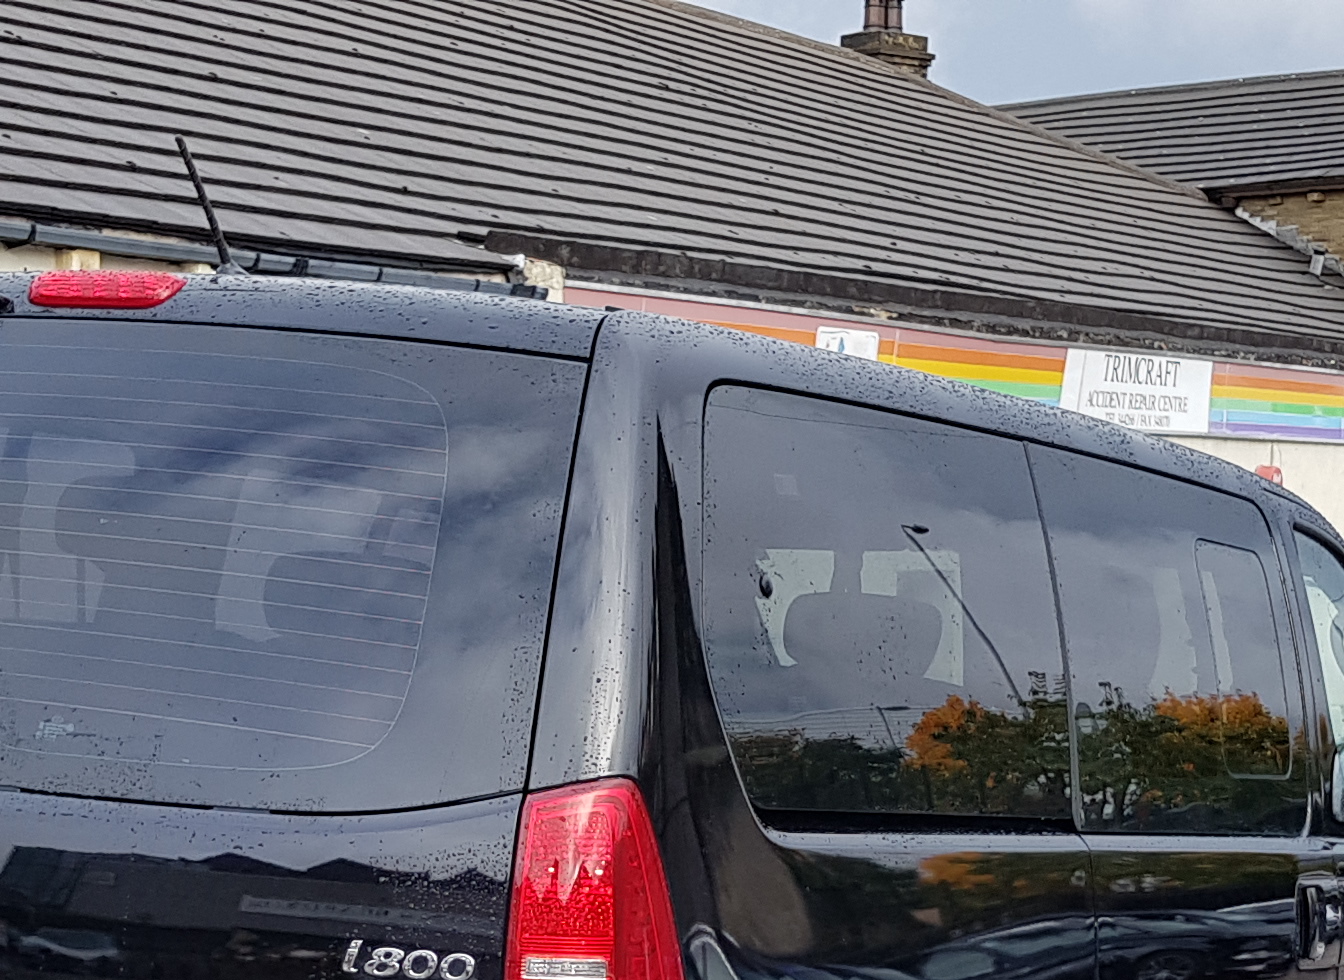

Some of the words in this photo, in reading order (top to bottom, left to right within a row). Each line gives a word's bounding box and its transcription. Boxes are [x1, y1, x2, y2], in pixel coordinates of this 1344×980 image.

[1104, 354, 1181, 387] TRIMCRAFT
[1086, 390, 1127, 409] ACCIDENT
[1128, 393, 1156, 411] REPAIR
[1157, 395, 1188, 413] CENTRE
